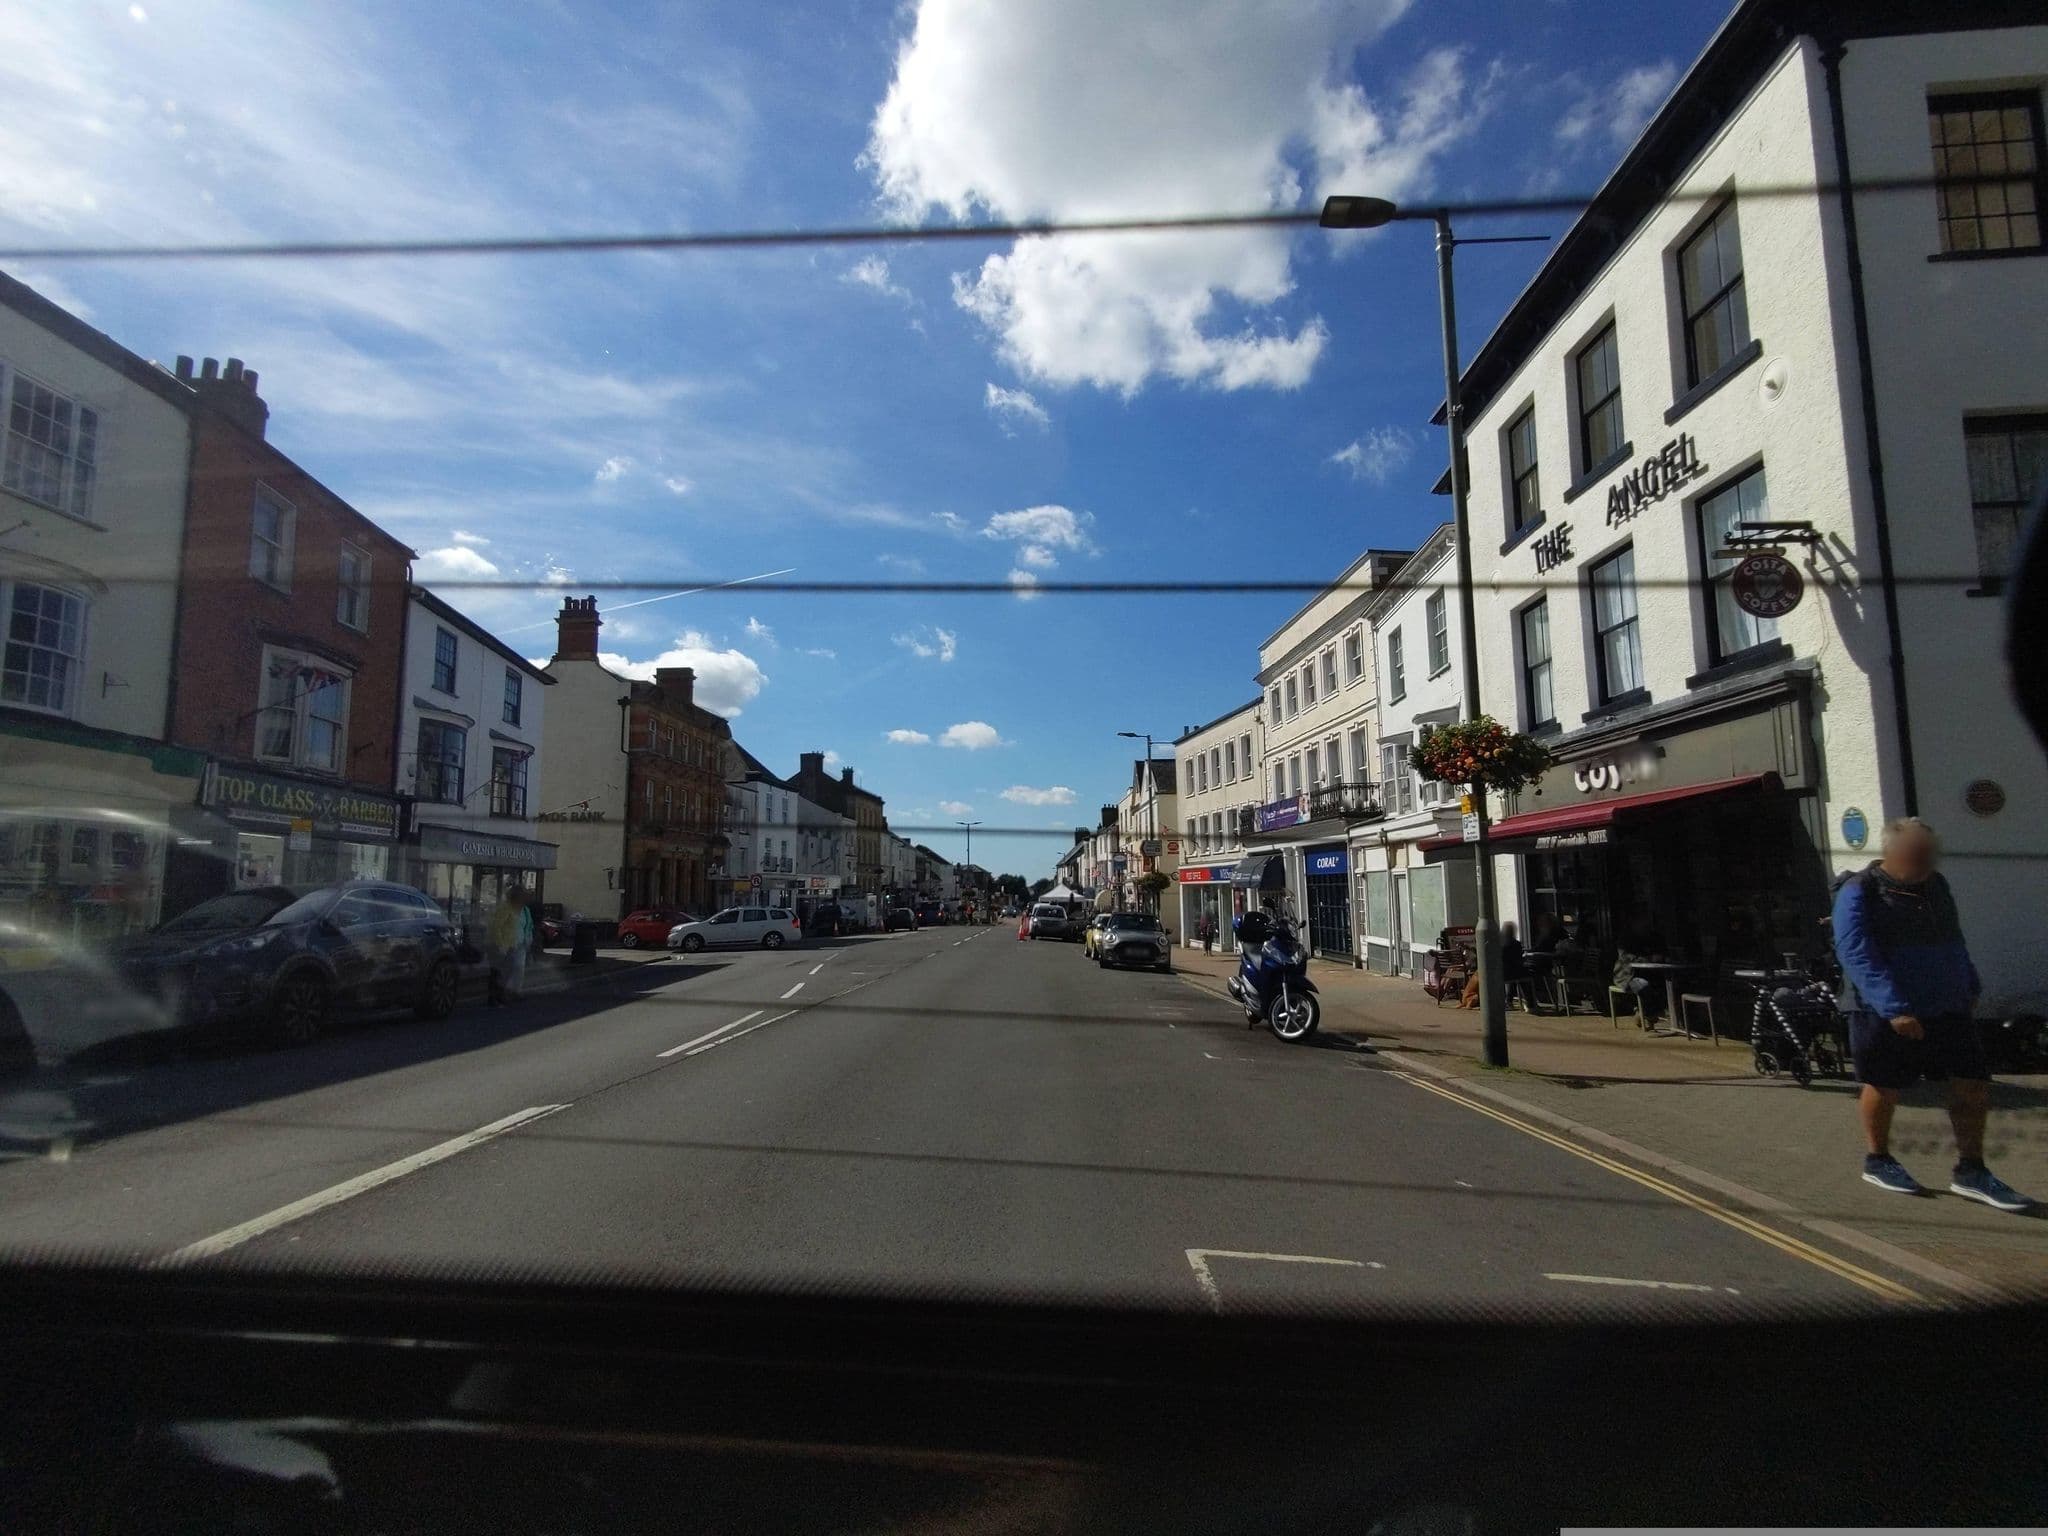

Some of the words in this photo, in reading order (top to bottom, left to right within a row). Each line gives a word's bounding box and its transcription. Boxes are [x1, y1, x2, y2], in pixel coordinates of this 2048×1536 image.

[1531, 521, 1571, 574] THE
[1606, 432, 1703, 526] ANGEL
[1743, 559, 1788, 576] COSTA
[1743, 591, 1797, 611] COFFEE
[217, 775, 255, 802] TOP
[259, 783, 314, 813] CLASS
[339, 797, 394, 825] BARBER
[570, 811, 606, 823] BANK
[1317, 856, 1337, 869] CORAL
